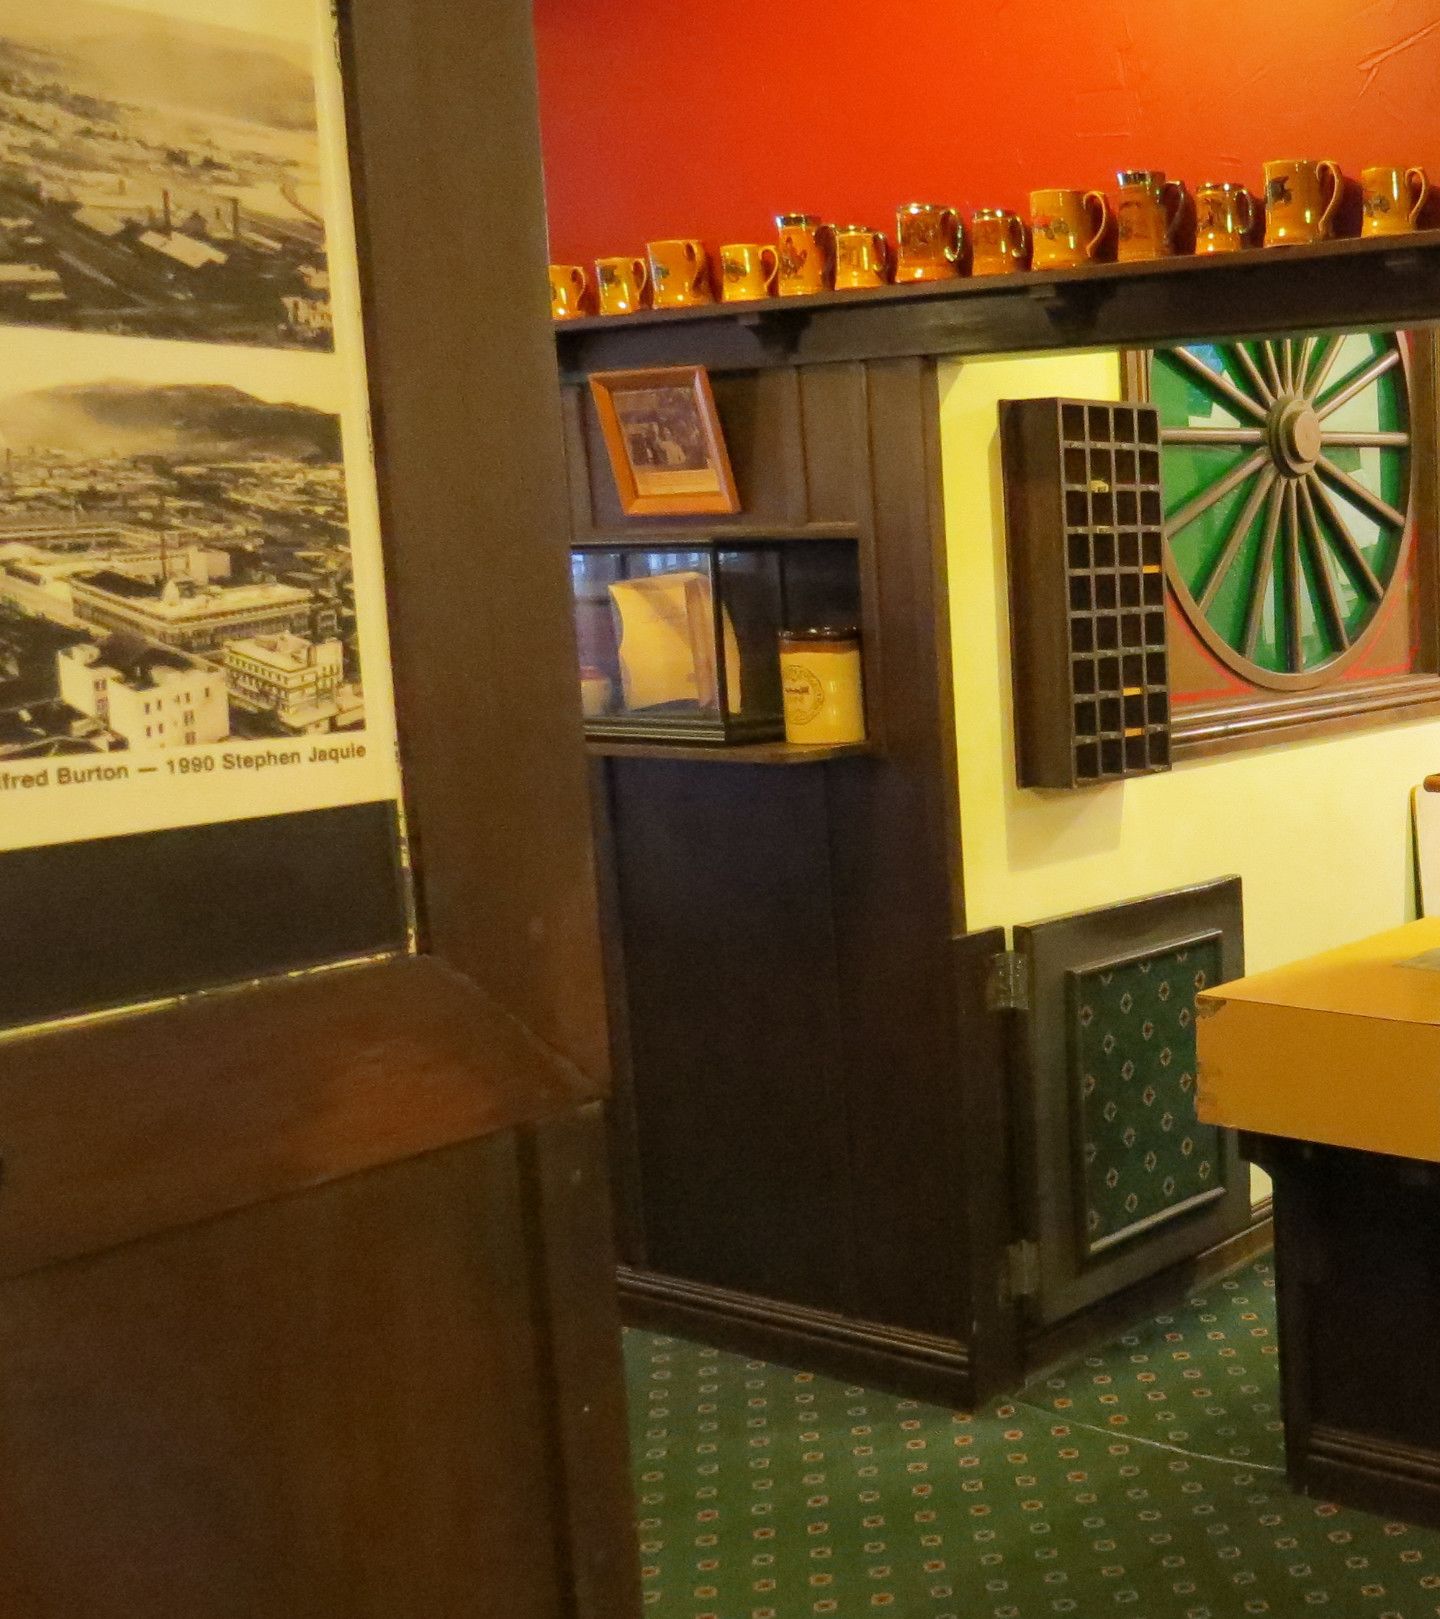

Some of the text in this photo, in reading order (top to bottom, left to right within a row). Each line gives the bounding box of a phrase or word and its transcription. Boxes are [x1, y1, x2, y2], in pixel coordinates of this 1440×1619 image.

[0, 769, 49, 791] fred
[57, 765, 129, 786] Burton
[166, 755, 215, 776] 1990
[222, 750, 301, 771] Stephen
